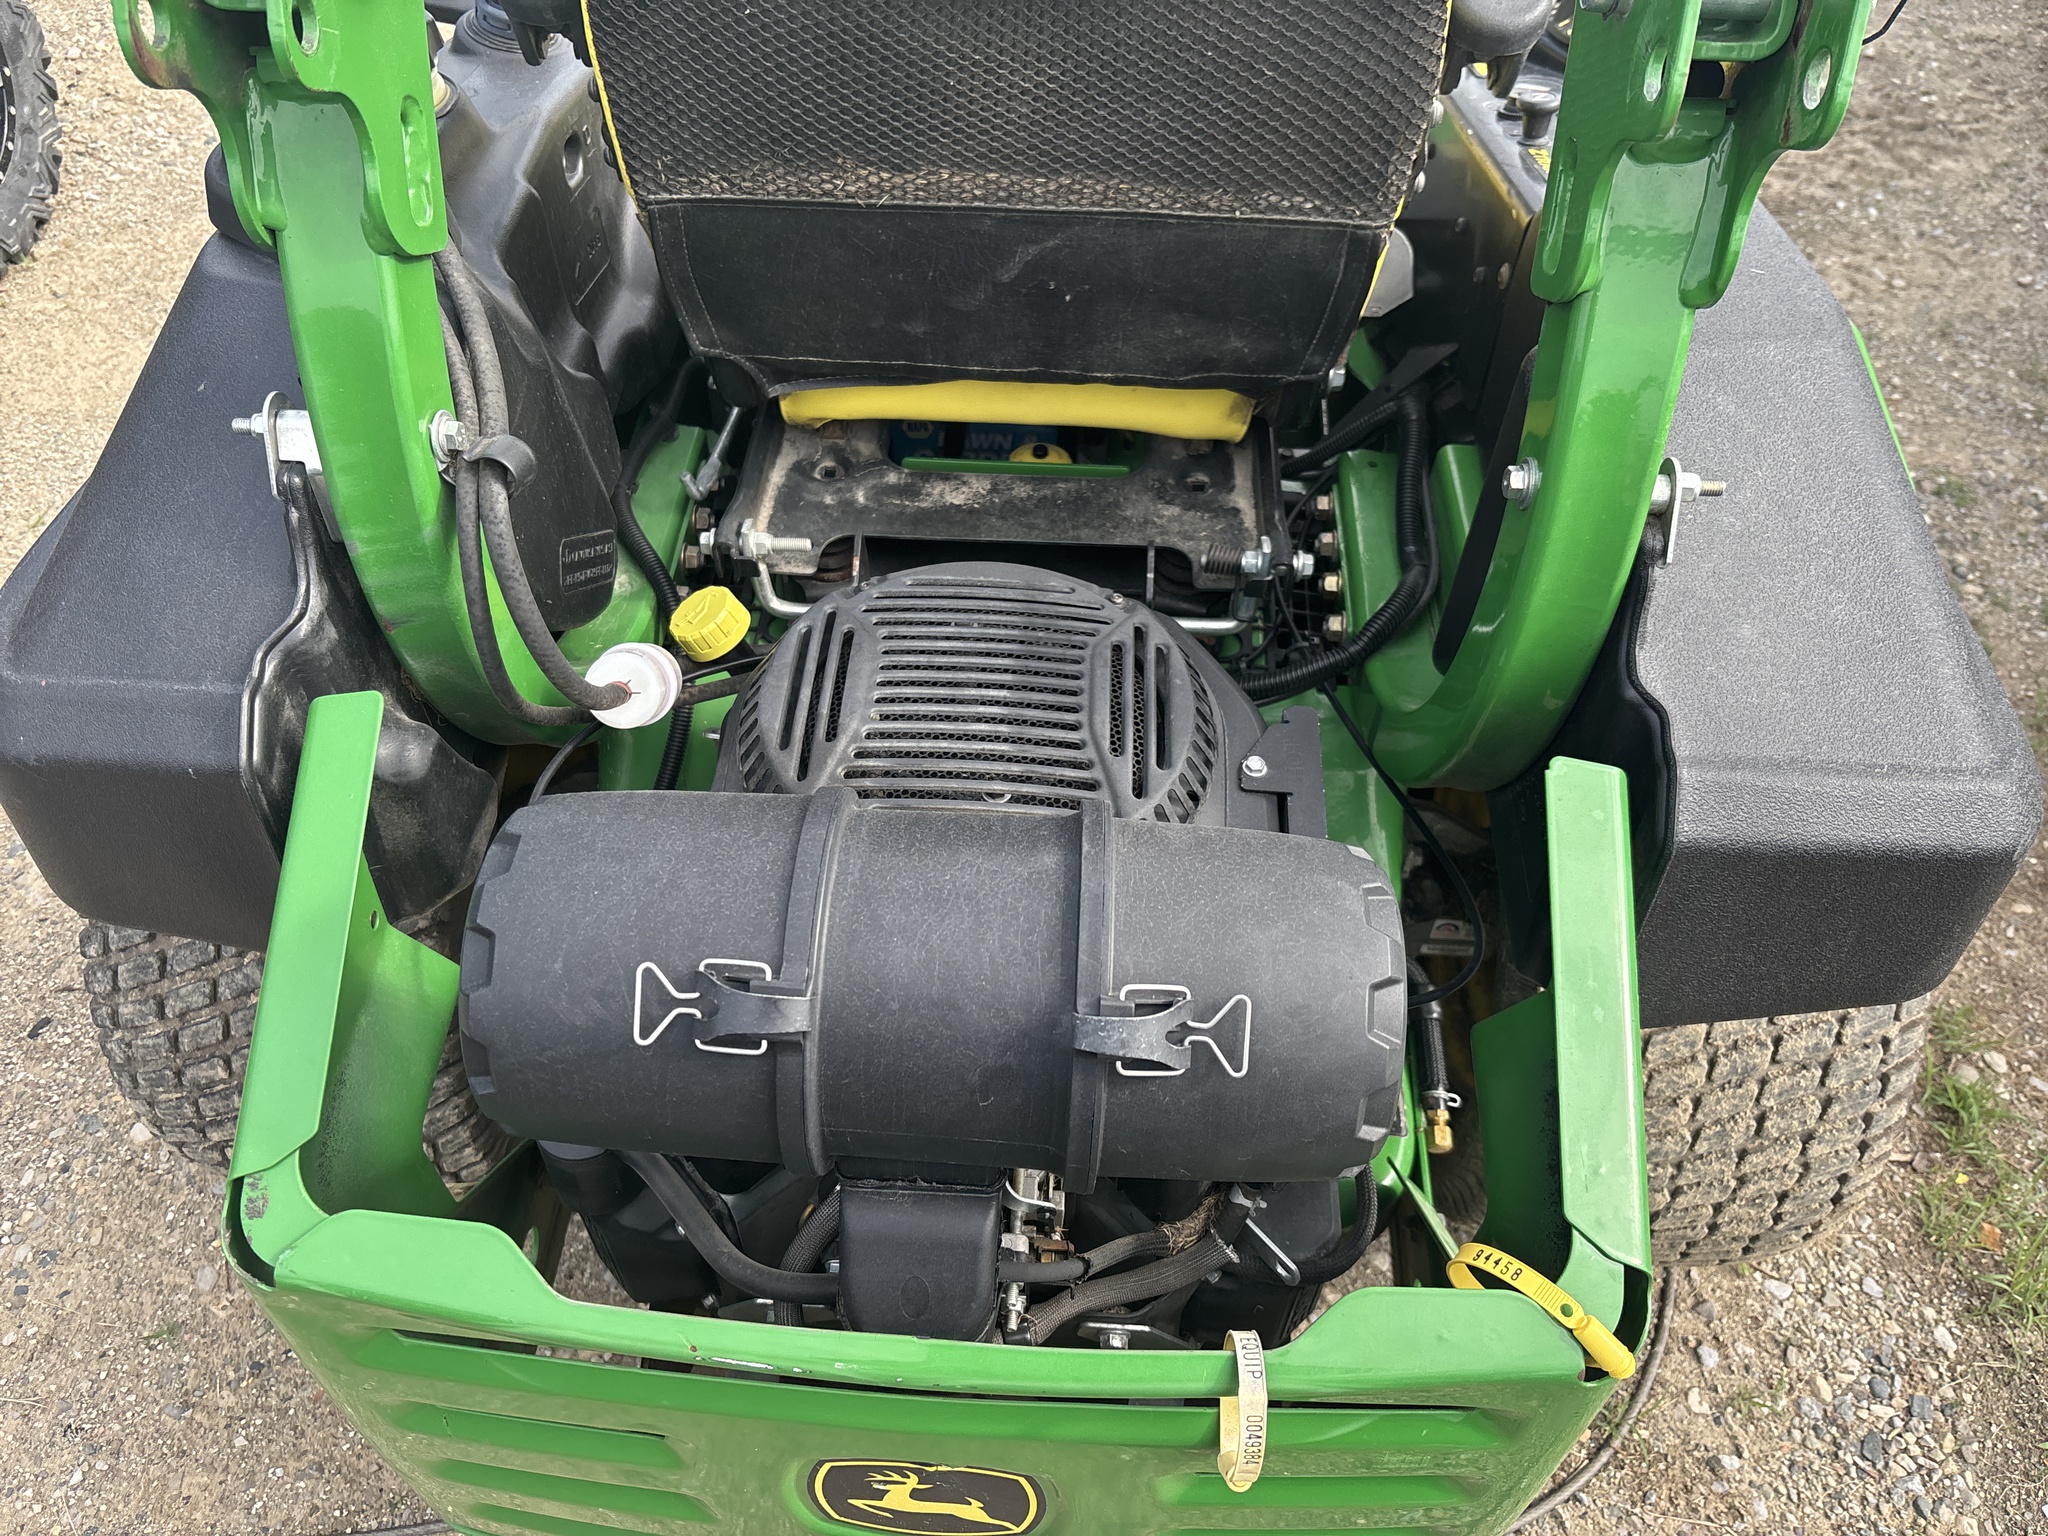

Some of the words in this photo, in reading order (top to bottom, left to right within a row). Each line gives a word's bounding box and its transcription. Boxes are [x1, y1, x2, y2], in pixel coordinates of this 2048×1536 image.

[1472, 1249, 1523, 1281] 94458
[1240, 1337, 1263, 1380] EQUIP
[1243, 1415, 1264, 1465] 0049384
